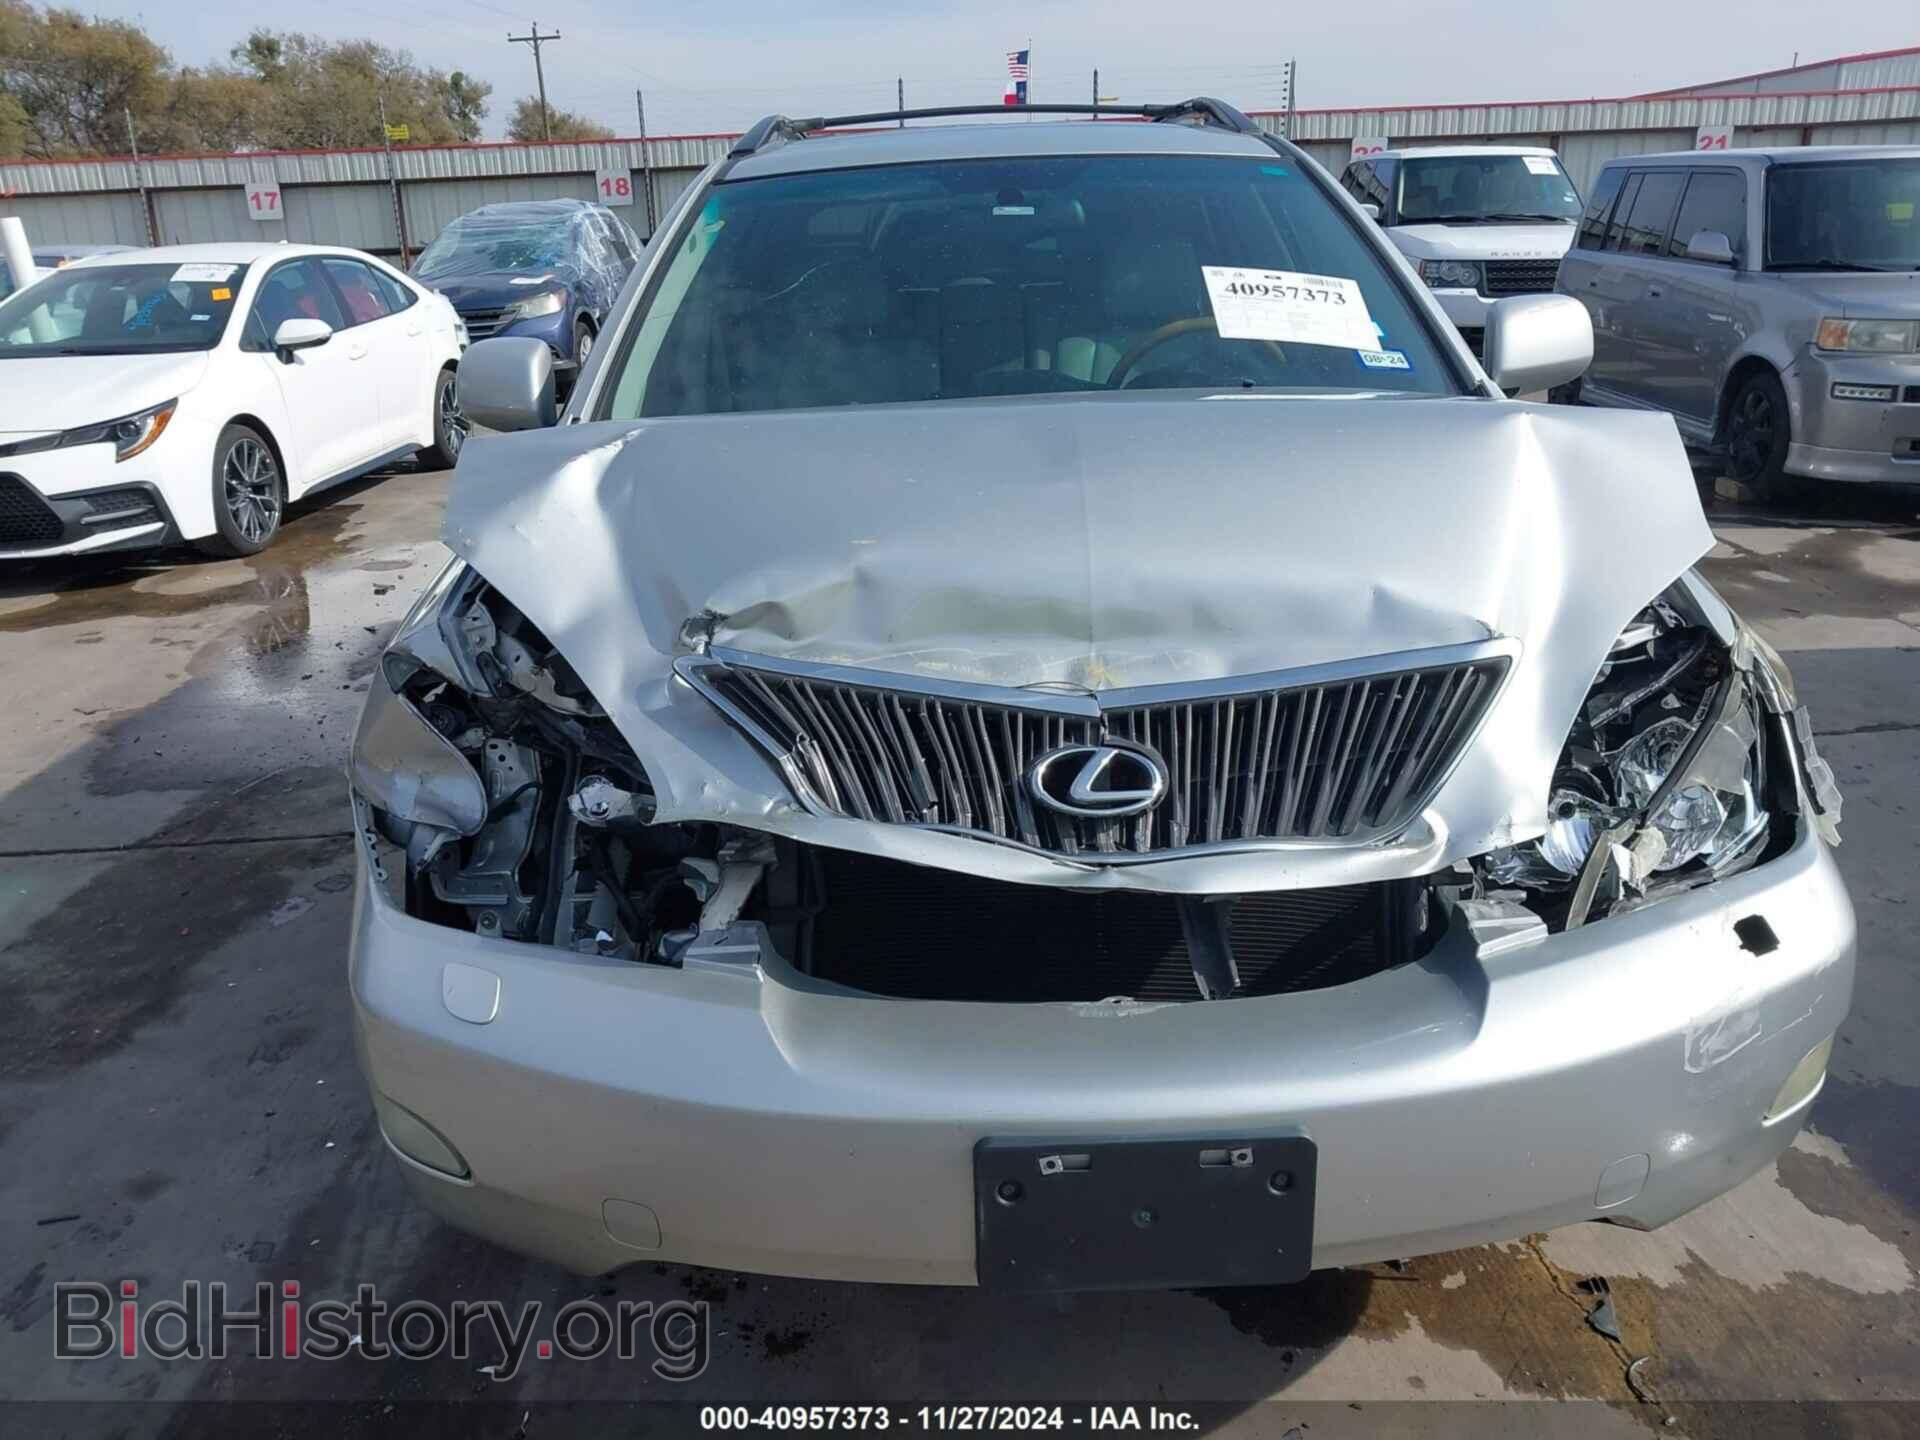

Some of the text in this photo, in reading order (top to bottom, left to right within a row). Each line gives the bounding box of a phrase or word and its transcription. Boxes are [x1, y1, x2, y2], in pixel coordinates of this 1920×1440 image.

[1699, 134, 1728, 150] 21
[601, 176, 630, 197] 18
[250, 191, 278, 211] 17
[1225, 281, 1347, 306] 40957373
